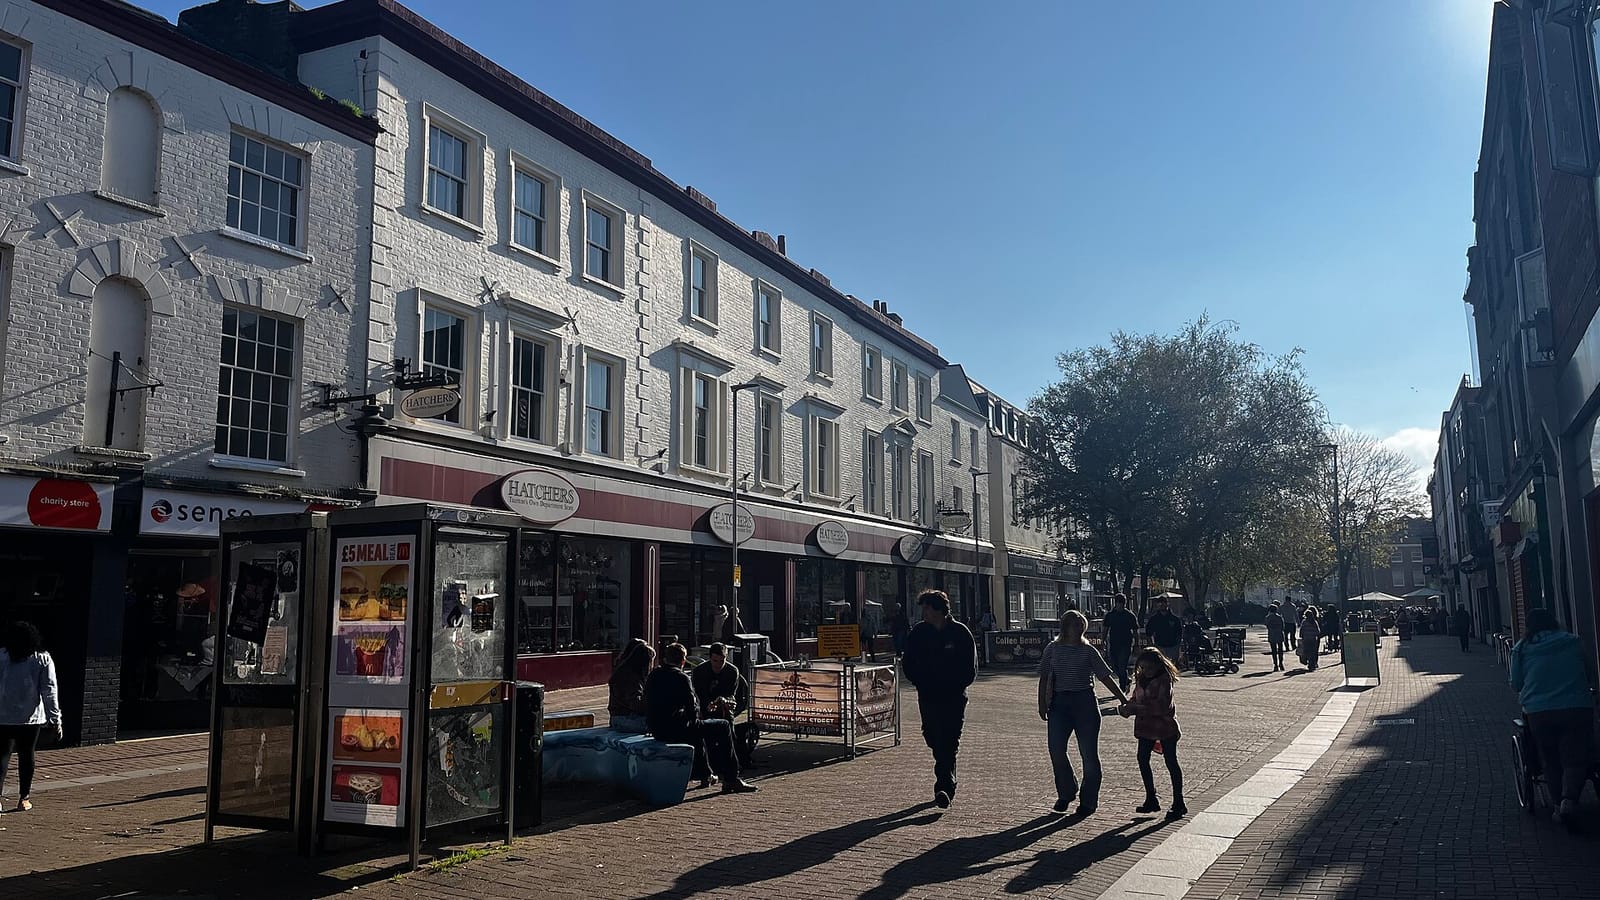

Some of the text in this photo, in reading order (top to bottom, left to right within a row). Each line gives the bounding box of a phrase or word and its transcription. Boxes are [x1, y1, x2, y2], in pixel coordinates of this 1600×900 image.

[406, 393, 454, 408] HATCHERS
[508, 480, 574, 504] HATCHERS
[40, 496, 90, 508] charity store
[342, 544, 356, 562] £5
[356, 543, 389, 562] MEAL
[995, 636, 1041, 645] Coffee Beans
[758, 714, 788, 722] TAUNTON
